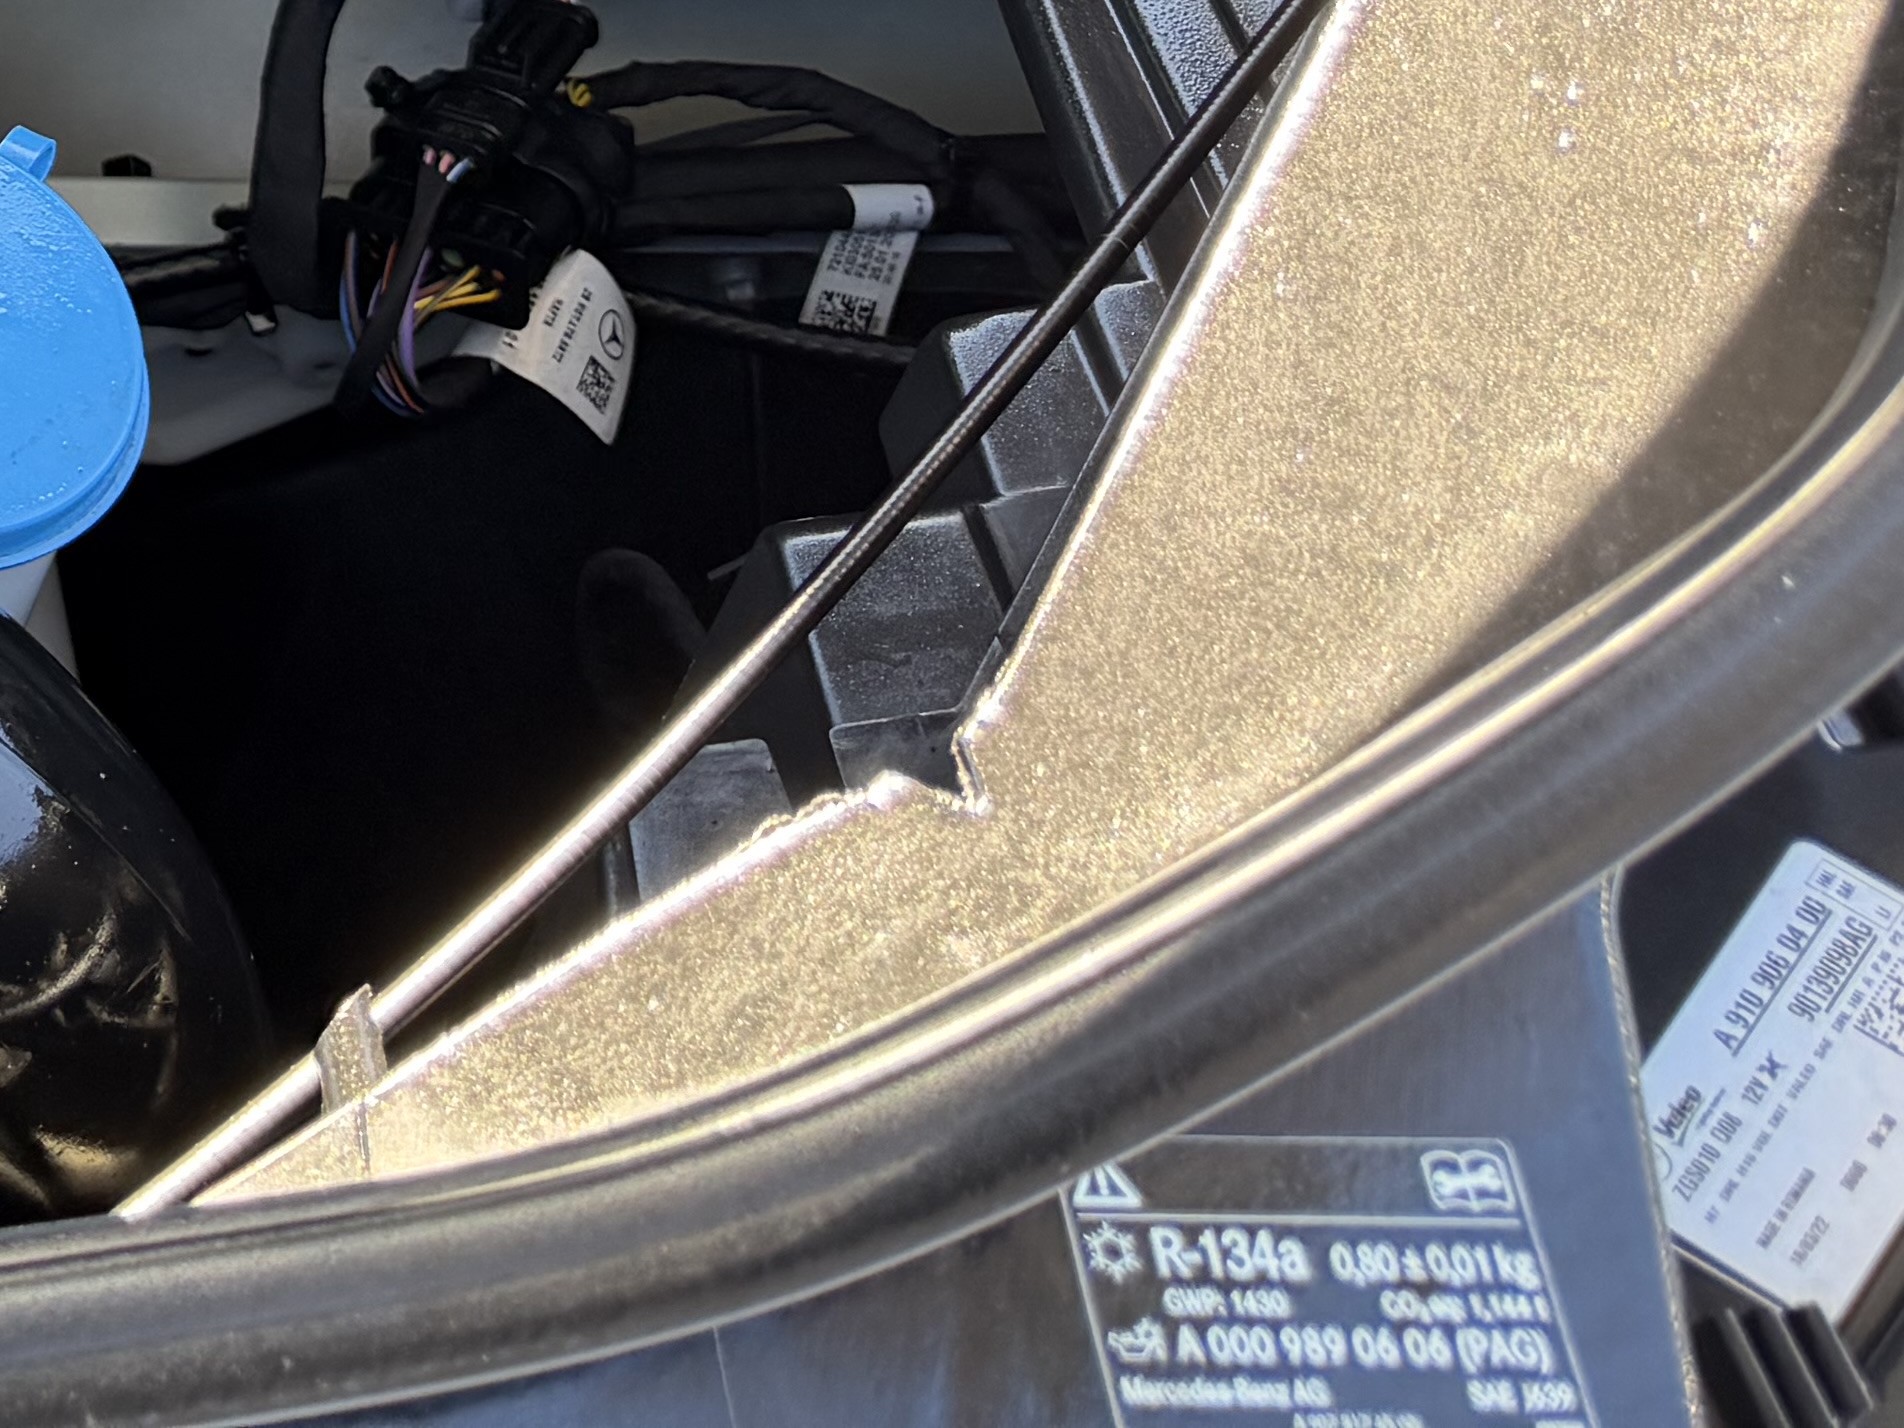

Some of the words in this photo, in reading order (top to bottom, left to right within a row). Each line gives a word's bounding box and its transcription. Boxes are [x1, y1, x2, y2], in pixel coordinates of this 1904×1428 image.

[1793, 893, 1828, 927] 00
[1775, 921, 1808, 954] 04
[1749, 947, 1791, 992] 906
[1786, 913, 1874, 1024] 90139098AG
[1723, 986, 1765, 1031] 910
[1709, 1024, 1740, 1051] A
[1651, 1079, 1704, 1142] Valeo
[1739, 1075, 1770, 1108] 12V
[1149, 1225, 1311, 1283] R-134a
[1495, 1245, 1541, 1291] kg
[1175, 1324, 1208, 1366] A
[1207, 1324, 1278, 1367] 000
[1279, 1325, 1348, 1368] 989
[1352, 1327, 1402, 1370] 06
[1404, 1327, 1454, 1371] 06
[1456, 1326, 1552, 1375] (PAG)
